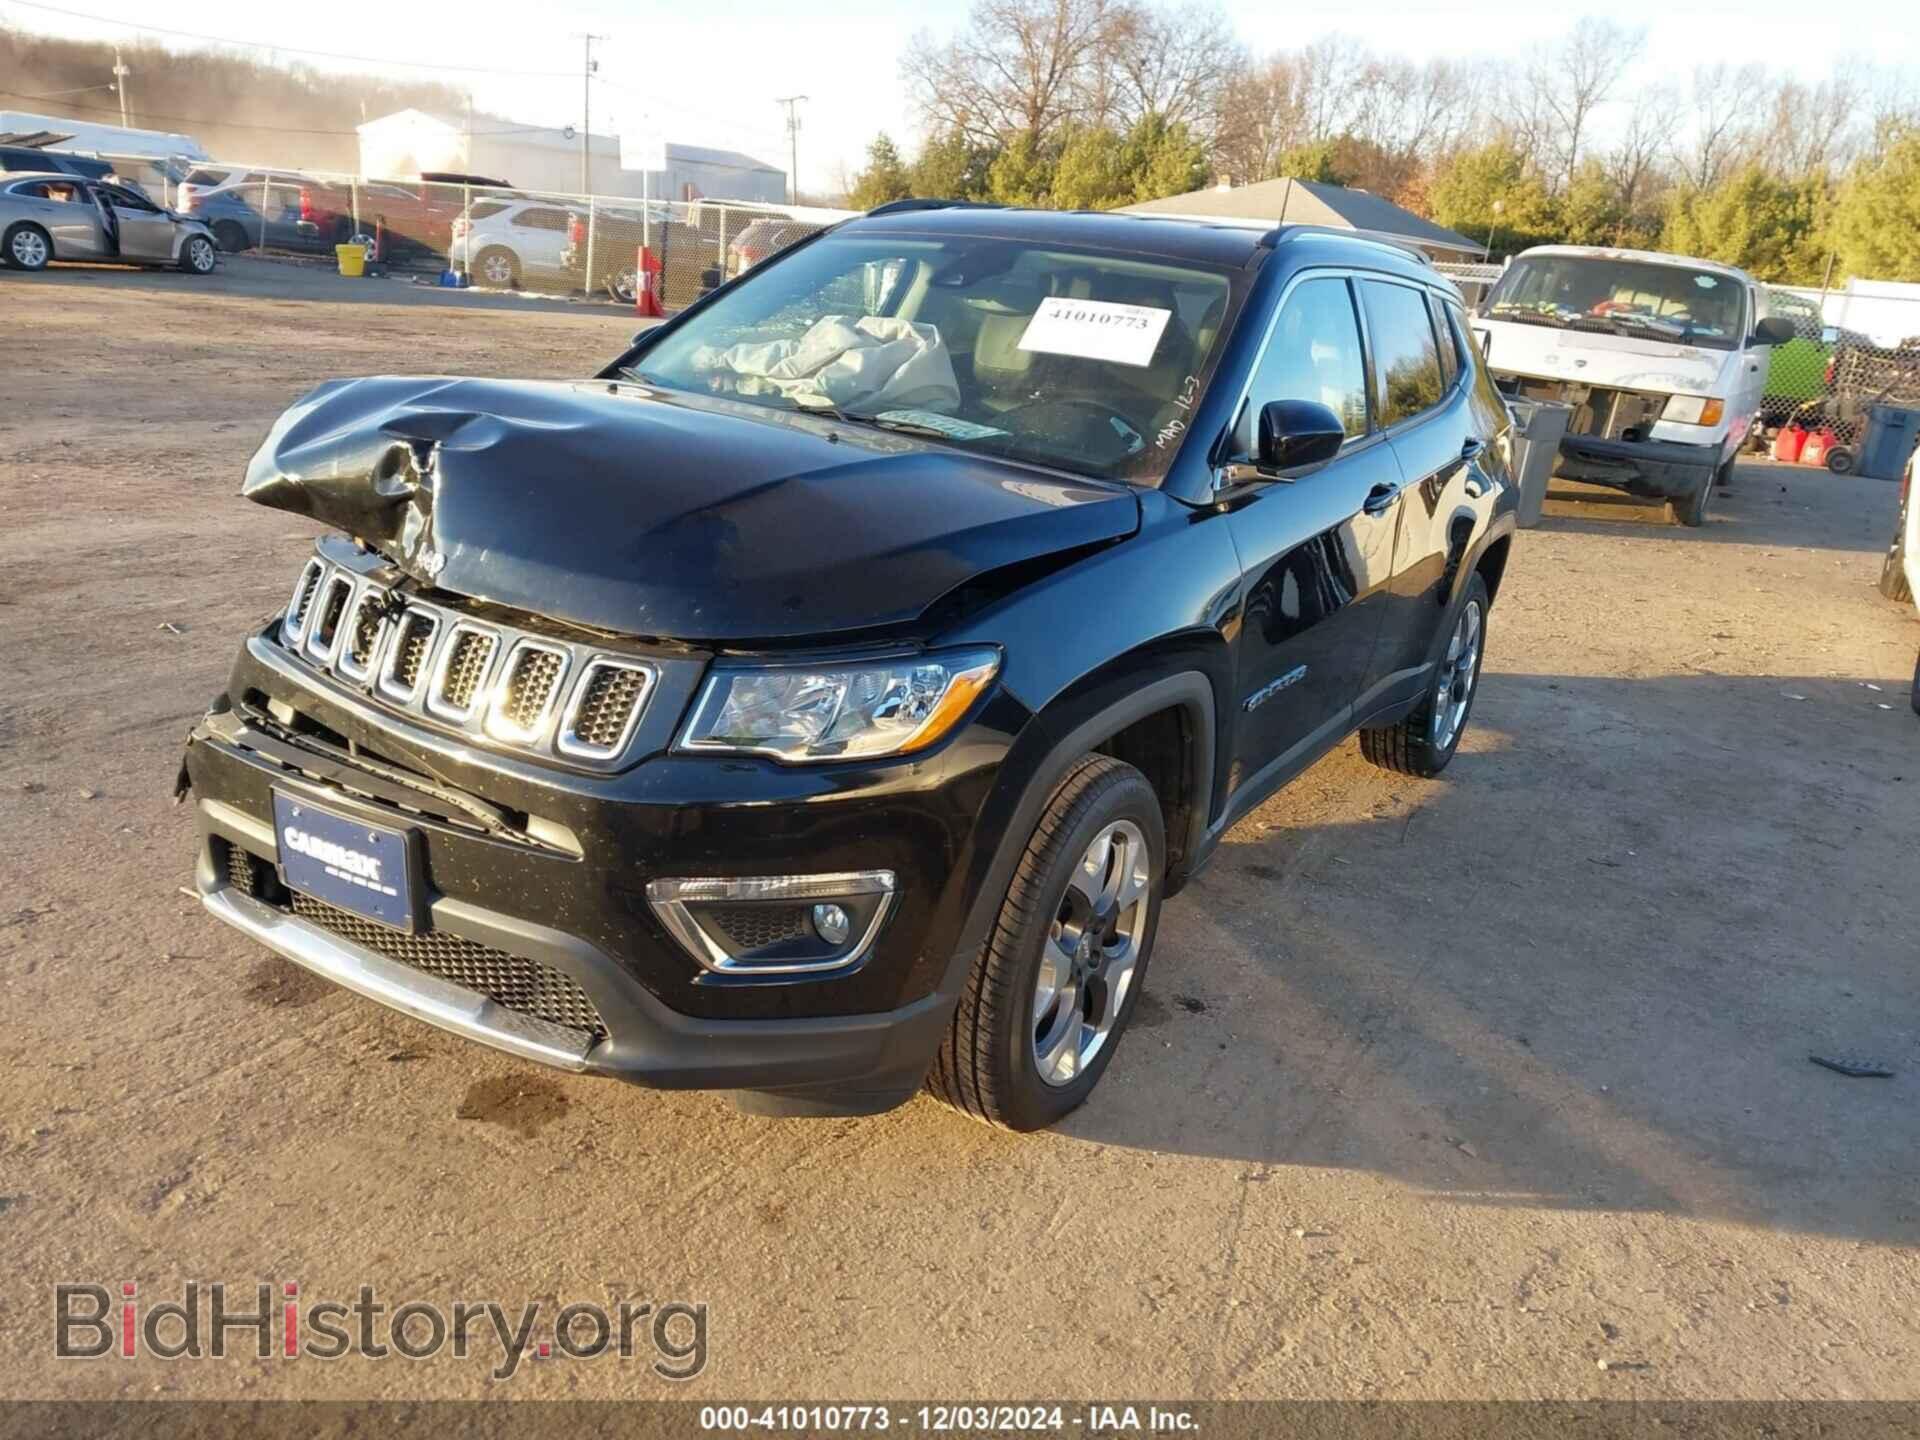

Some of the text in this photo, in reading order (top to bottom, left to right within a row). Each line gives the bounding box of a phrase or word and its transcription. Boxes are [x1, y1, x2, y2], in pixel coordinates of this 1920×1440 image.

[1048, 309, 1148, 329] 41010773
[1155, 375, 1199, 449] MAD 12-3
